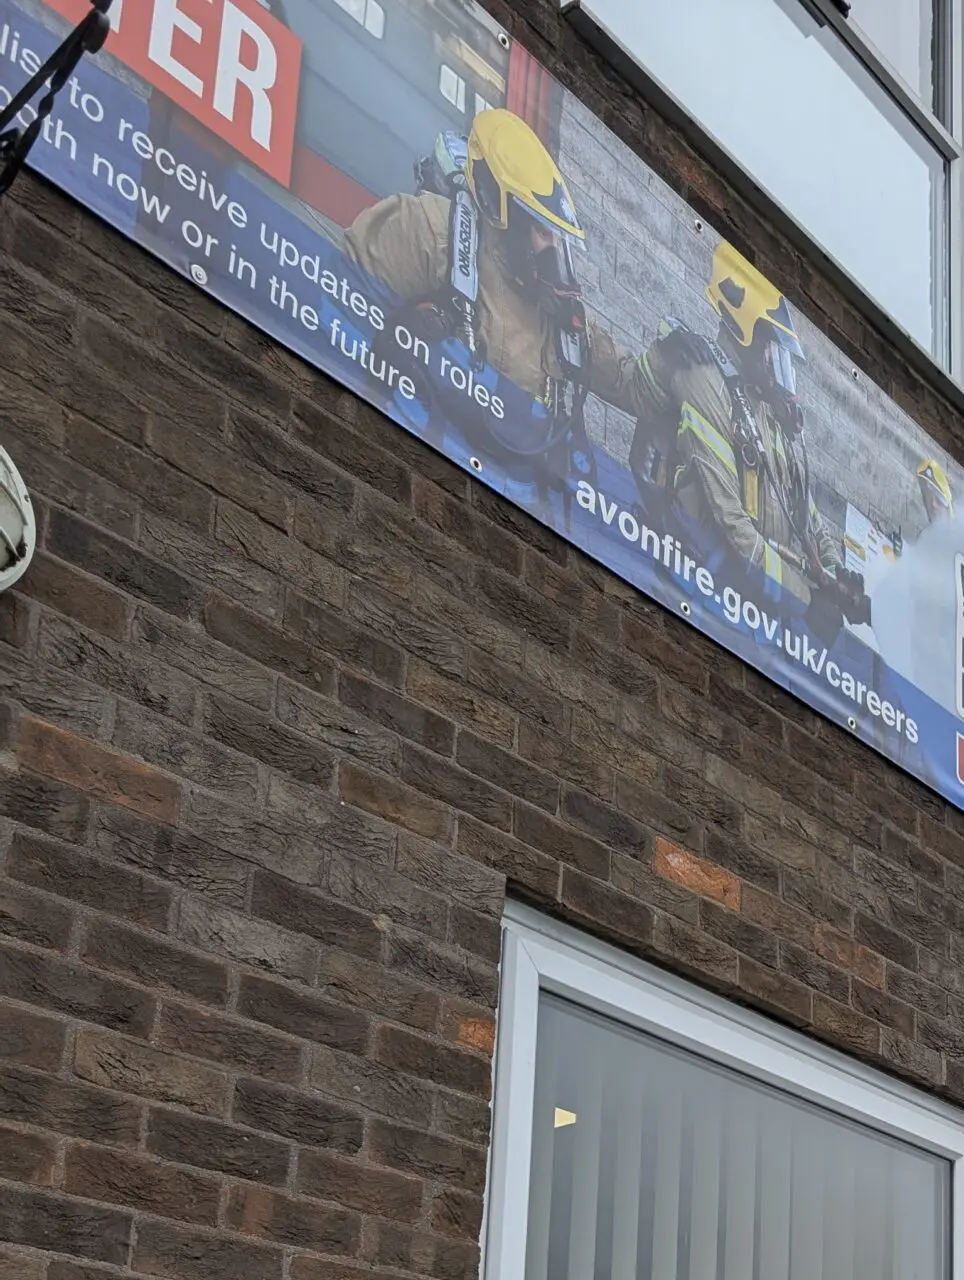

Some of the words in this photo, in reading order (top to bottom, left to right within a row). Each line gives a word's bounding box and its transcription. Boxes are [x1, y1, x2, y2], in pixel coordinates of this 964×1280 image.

[107, 0, 277, 152] ER
[0, 24, 52, 89] lis
[67, 76, 105, 123] to
[118, 118, 248, 228] receive
[260, 223, 385, 330] updates
[395, 324, 430, 366] on
[440, 356, 506, 420] roles
[93, 153, 171, 224] now
[181, 220, 219, 258] or
[229, 245, 257, 288] in
[270, 275, 320, 331] the
[330, 319, 417, 400] future
[459, 203, 473, 278] INTERSPIRO
[576, 480, 919, 745] avonfire.gov.uk/careers
